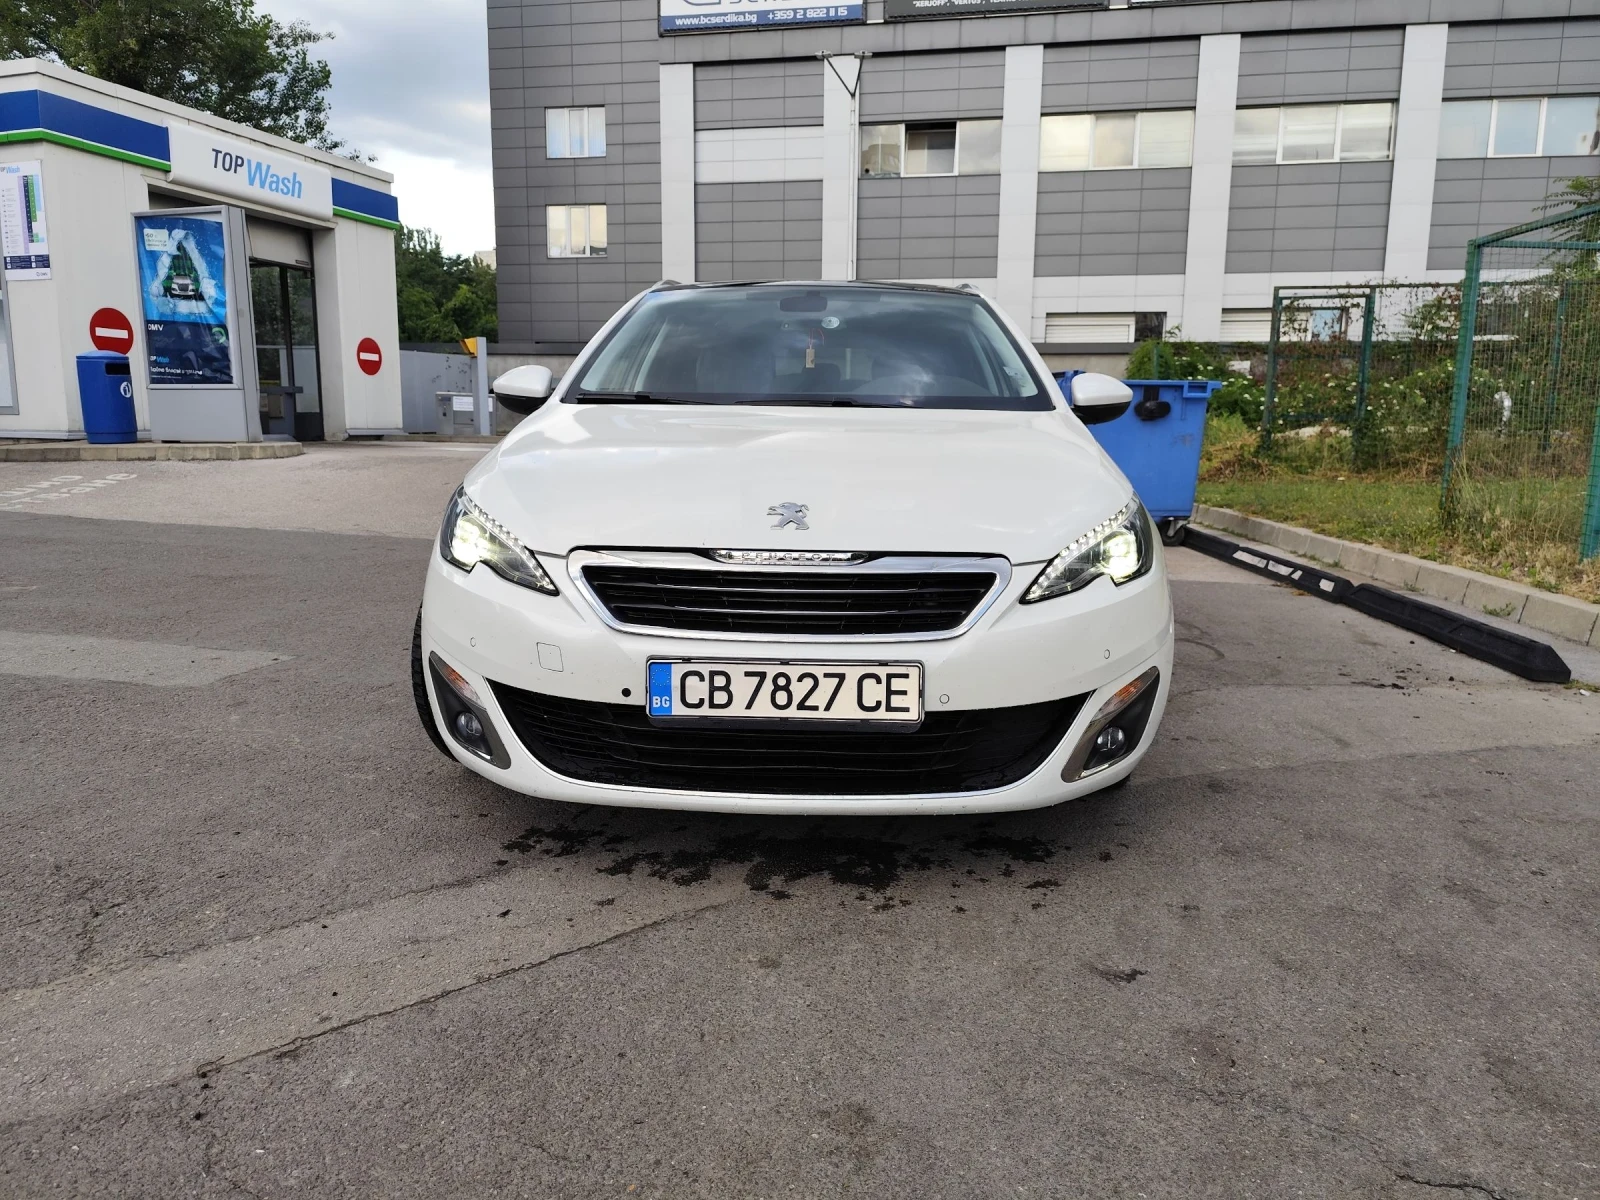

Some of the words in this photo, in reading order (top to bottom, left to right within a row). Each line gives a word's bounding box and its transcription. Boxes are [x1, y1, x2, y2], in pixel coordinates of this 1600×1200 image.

[675, 13, 757, 26] www.bcserdika.bg
[767, 10, 794, 20] +359
[796, 9, 804, 19] 2
[806, 8, 827, 18] 822
[829, 7, 835, 17] 11
[838, 6, 848, 16] 15
[212, 147, 244, 174] TOP
[246, 158, 303, 199] Wash
[741, 552, 836, 562] PEUGEOT
[680, 670, 734, 709] CB
[744, 671, 847, 712] 7827
[857, 672, 911, 713] CE
[652, 696, 670, 708] BG
